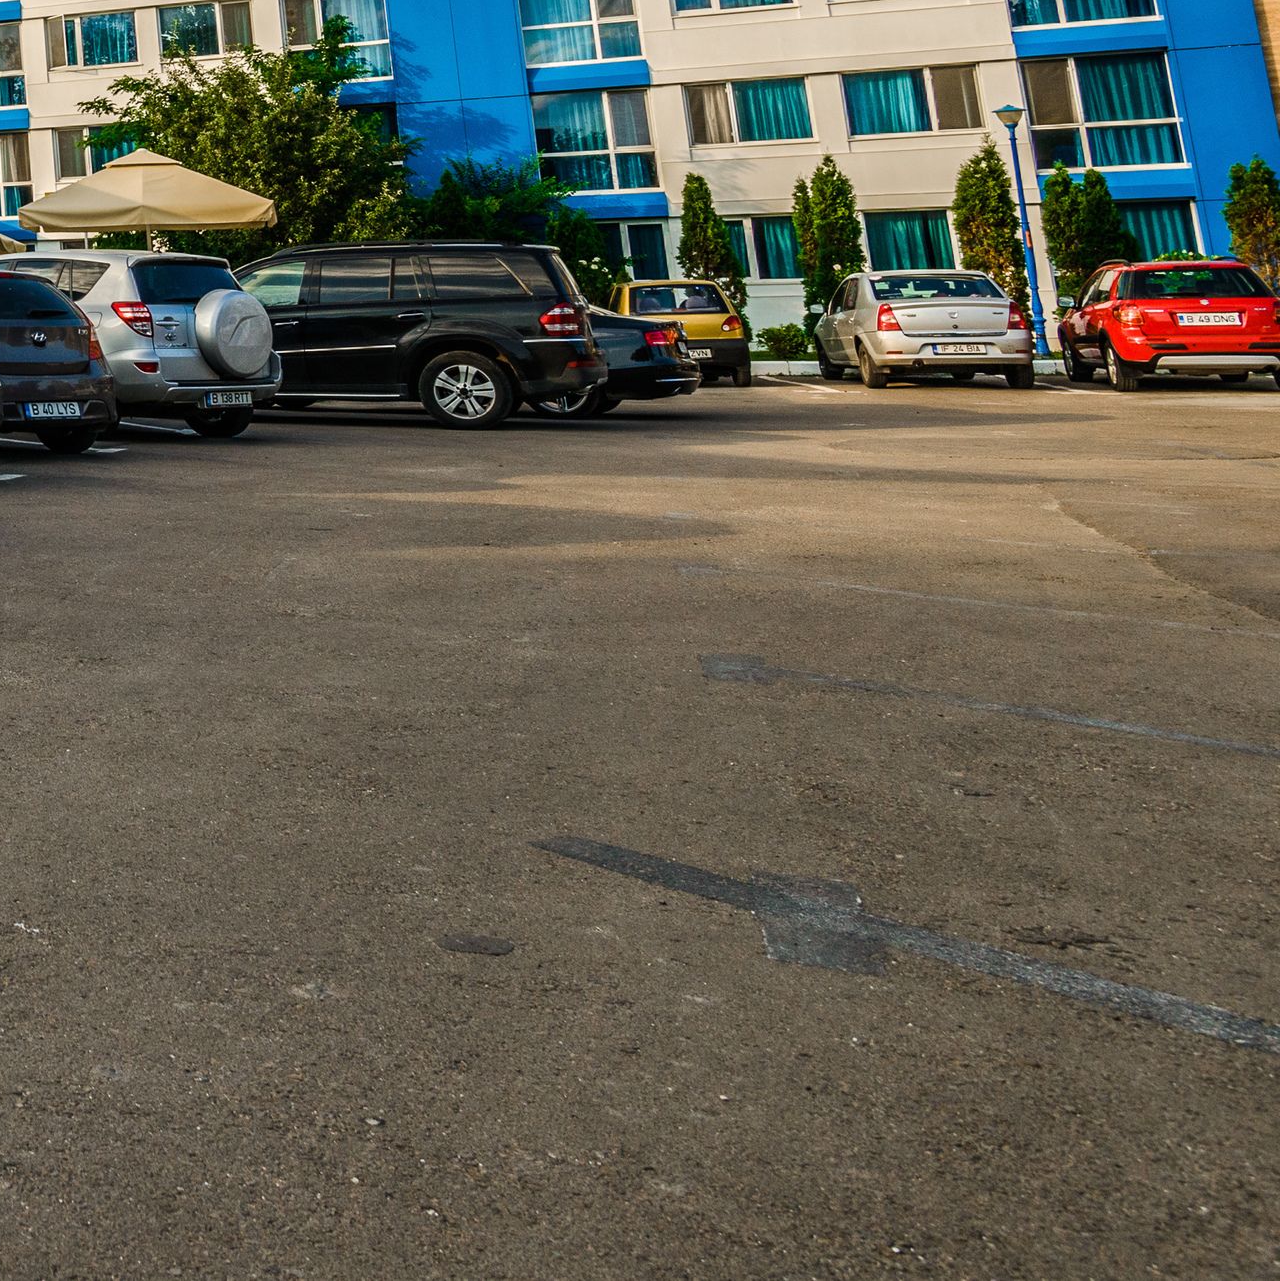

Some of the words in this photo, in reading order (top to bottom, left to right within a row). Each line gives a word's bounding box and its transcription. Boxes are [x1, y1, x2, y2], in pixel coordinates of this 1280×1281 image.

[1198, 315, 1211, 323] 49
[234, 392, 249, 403] RTT
[31, 403, 40, 415] B
[43, 403, 53, 415] 40
[56, 403, 76, 415] LYS
